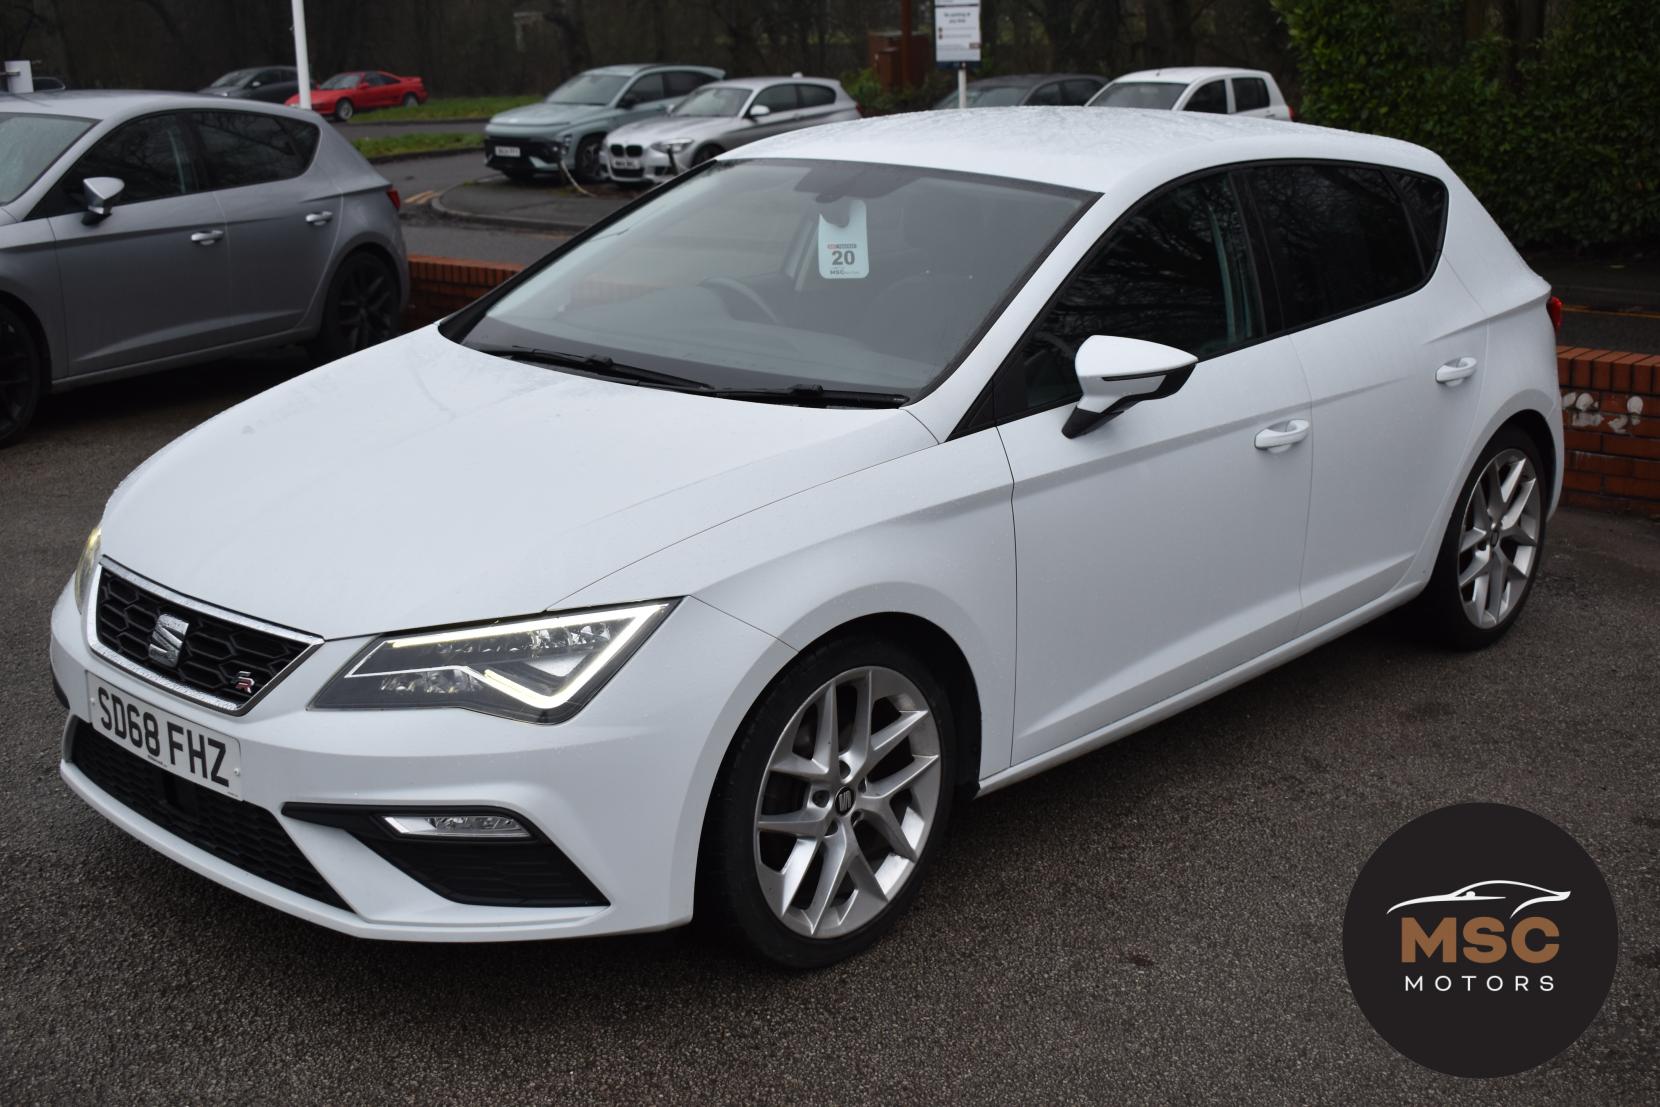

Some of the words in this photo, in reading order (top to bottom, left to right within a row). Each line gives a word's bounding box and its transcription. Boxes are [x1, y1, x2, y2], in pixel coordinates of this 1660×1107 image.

[832, 250, 855, 265] 20
[97, 686, 160, 757] SD68
[167, 721, 230, 788] FHZ
